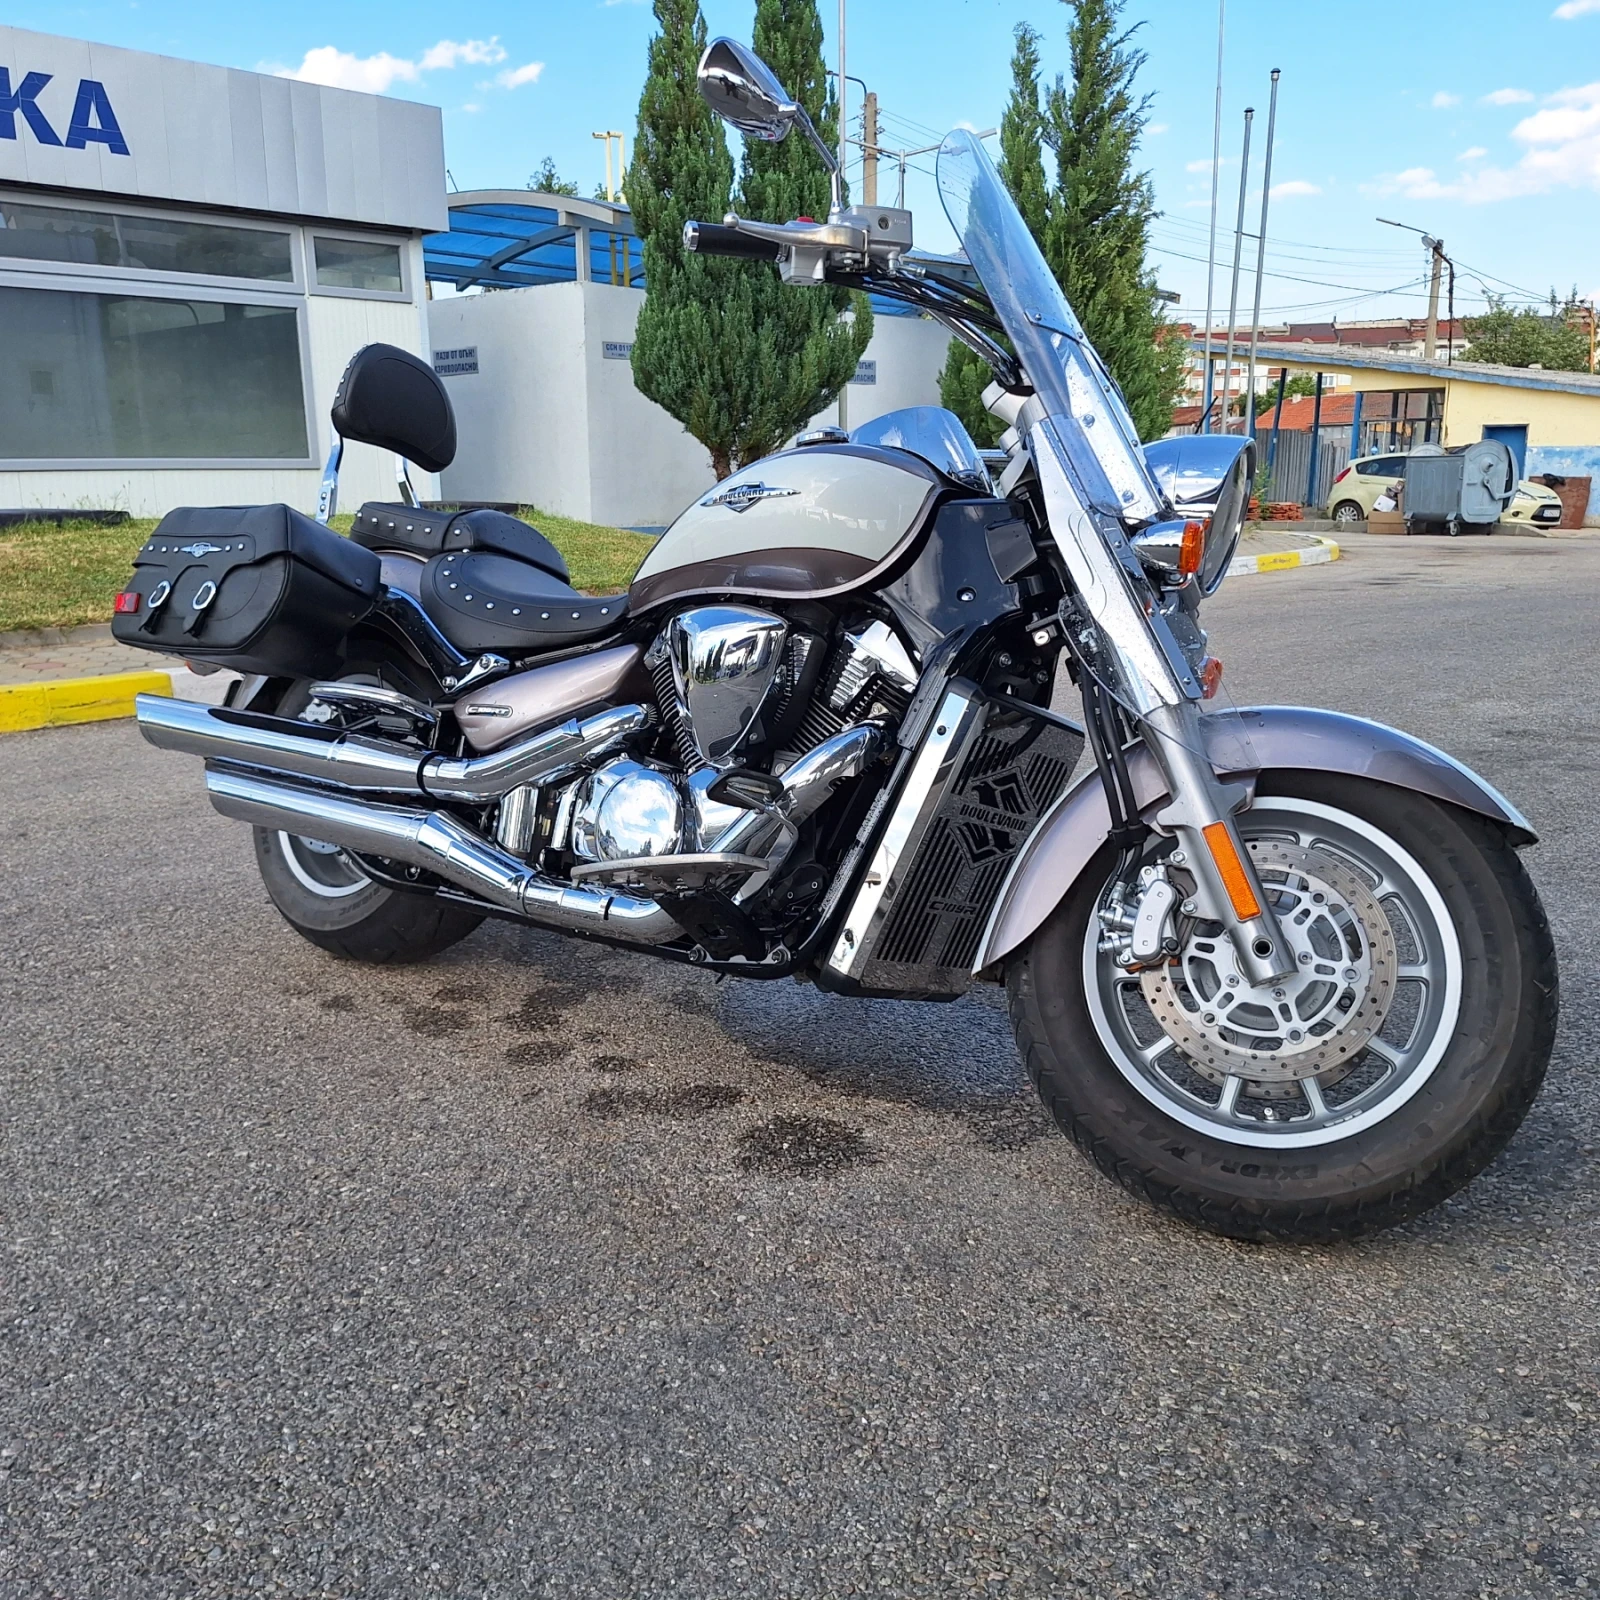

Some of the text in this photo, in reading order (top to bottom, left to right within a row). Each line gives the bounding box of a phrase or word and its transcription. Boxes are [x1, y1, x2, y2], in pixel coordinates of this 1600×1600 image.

[435, 348, 475, 360] ПАЗИ ОТ ОГЪН!
[859, 361, 874, 370] ОГЪН!
[718, 488, 765, 502] BOULEVARD
[960, 804, 1027, 831] BOULEVARD
